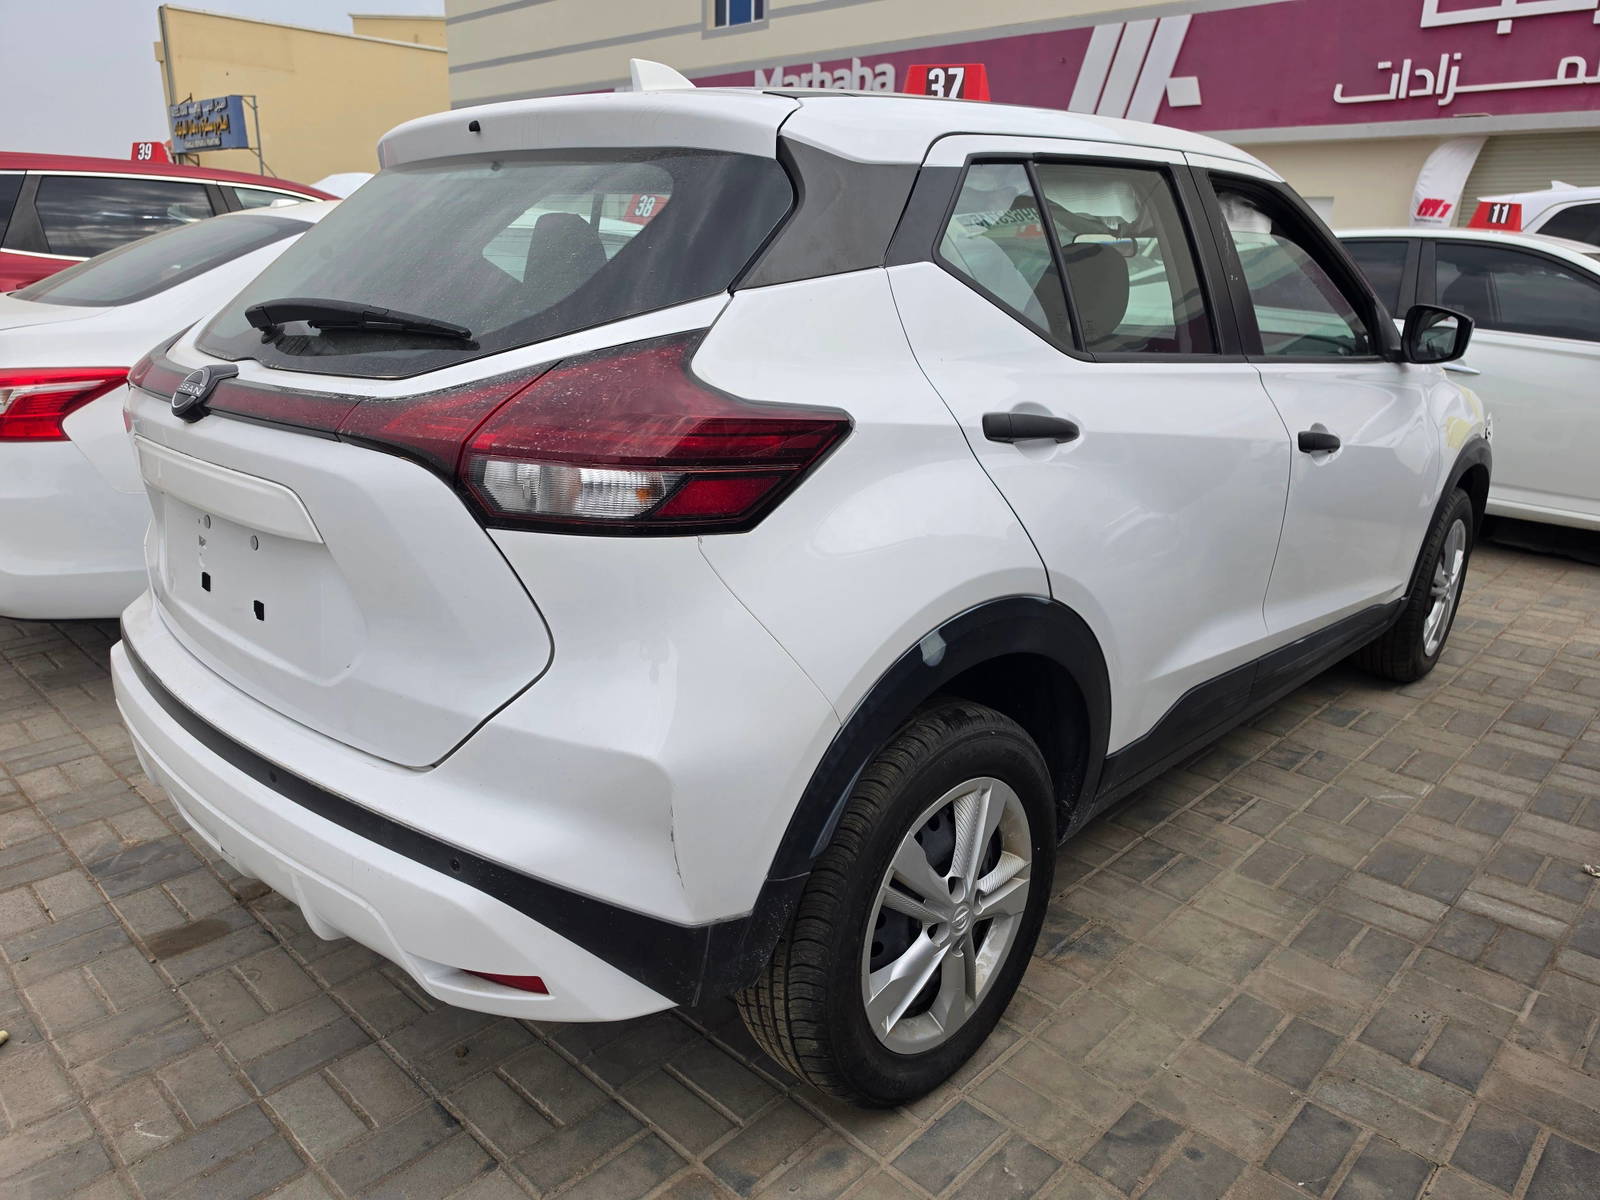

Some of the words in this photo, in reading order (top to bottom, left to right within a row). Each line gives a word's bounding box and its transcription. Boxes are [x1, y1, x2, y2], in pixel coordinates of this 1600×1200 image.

[755, 58, 895, 92] Marhaba
[928, 67, 965, 100] 37
[137, 143, 152, 160] 39
[634, 194, 656, 217] 38
[1491, 204, 1510, 224] 11
